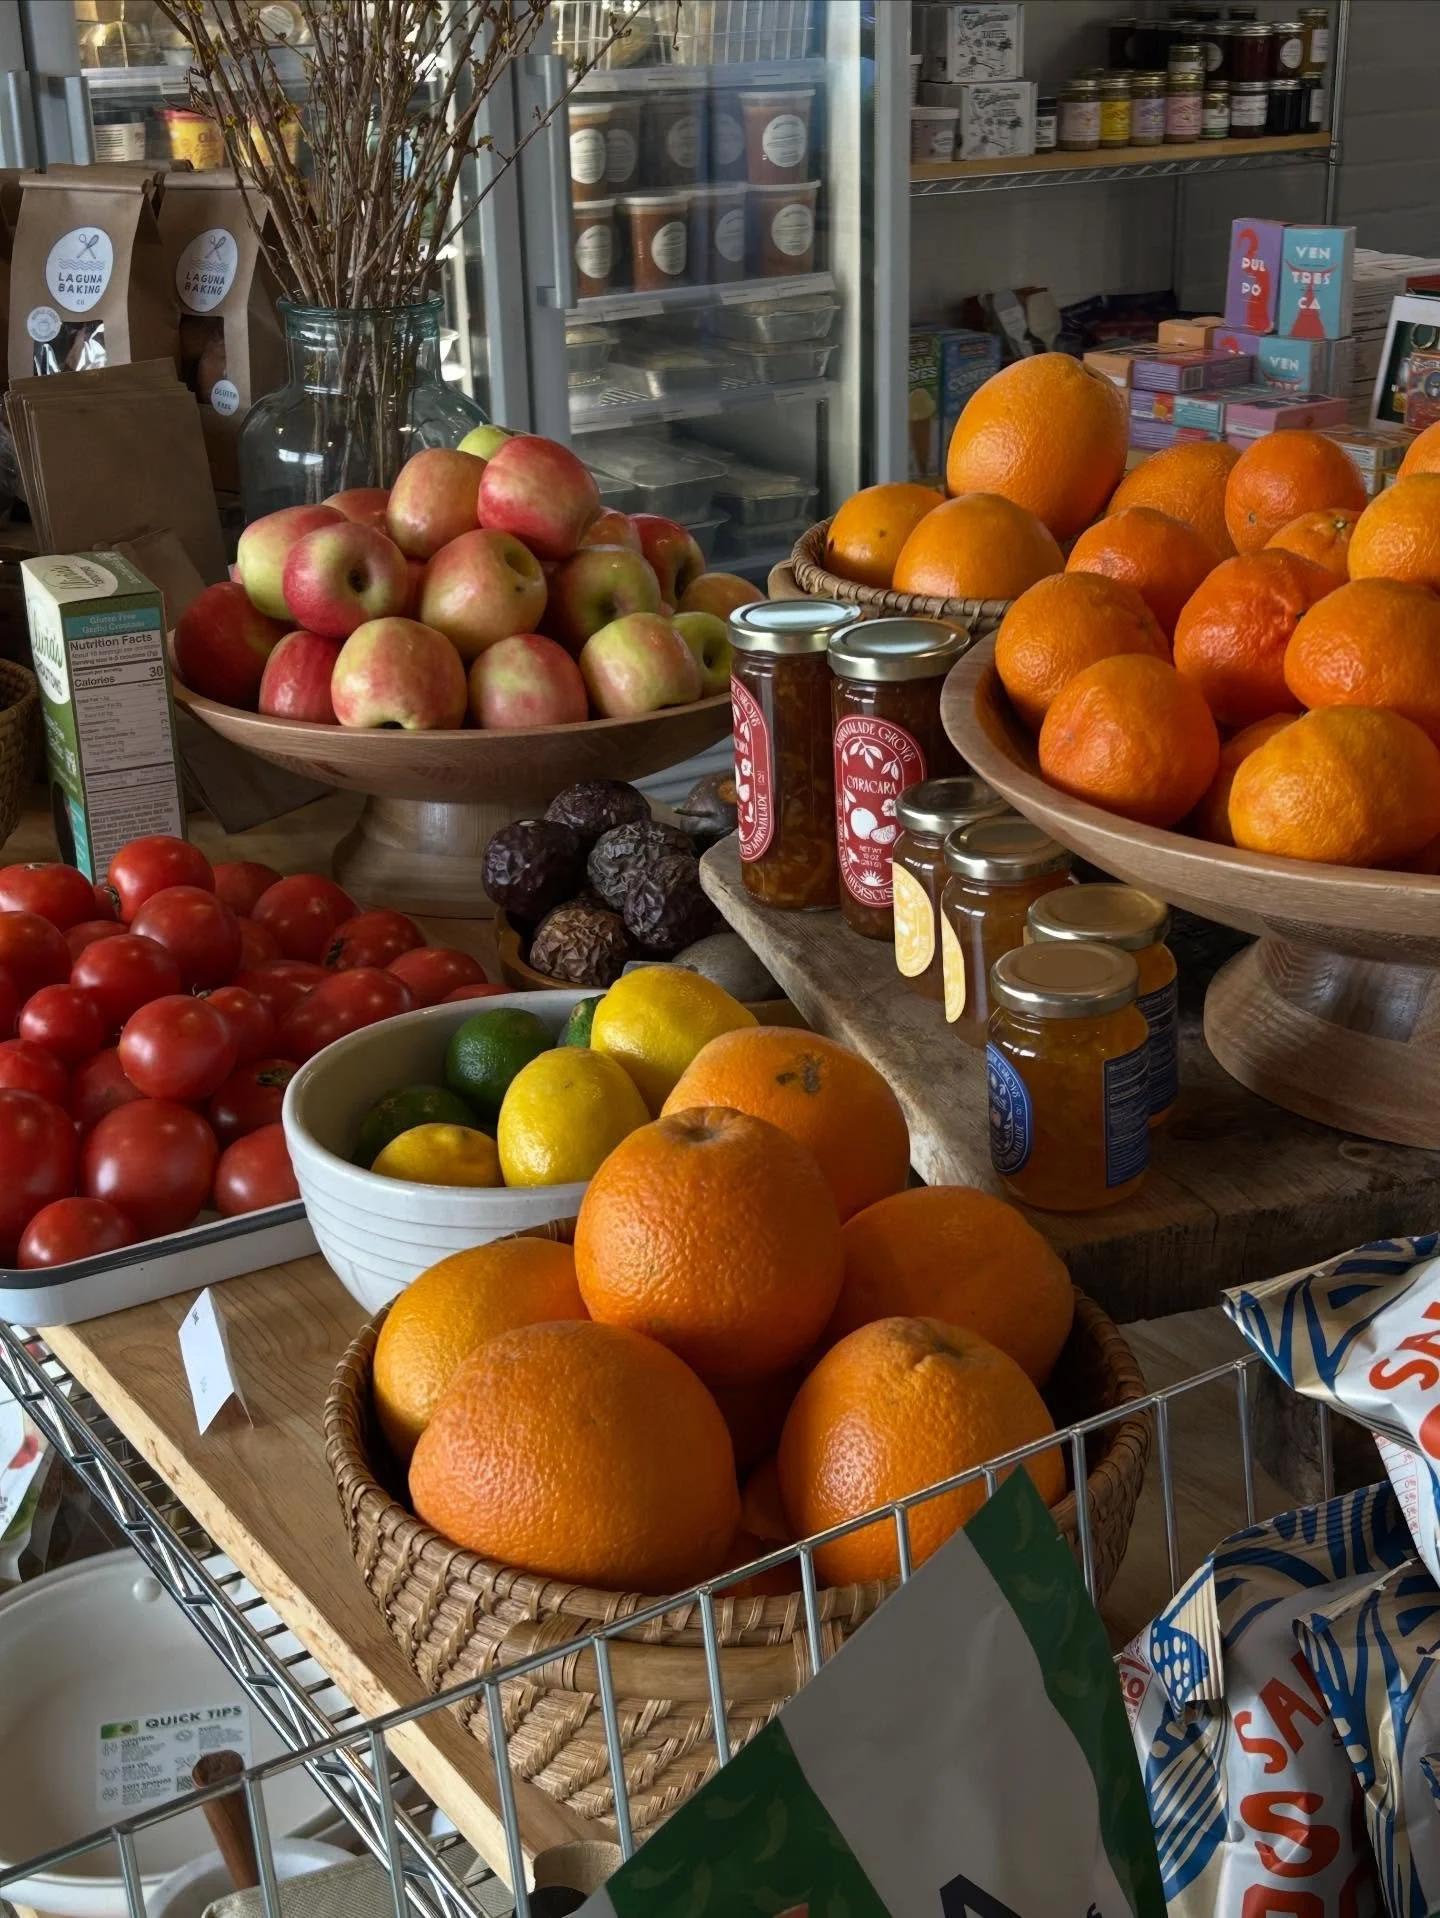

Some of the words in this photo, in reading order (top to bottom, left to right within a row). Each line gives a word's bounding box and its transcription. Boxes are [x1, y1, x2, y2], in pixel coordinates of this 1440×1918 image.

[1296, 246, 1331, 260] VEN
[1241, 257, 1267, 272] PUL
[58, 272, 103, 284] LAGUNA
[186, 272, 226, 285] LAGUNA
[1292, 271, 1331, 286] TRES
[58, 283, 101, 295] BAKING
[184, 282, 223, 295] BAKING
[1241, 282, 1262, 297] PO
[1297, 296, 1321, 310] CA
[1269, 356, 1300, 371] VEN
[70, 638, 119, 650] Nutrition
[122, 634, 152, 645] Facts
[149, 665, 164, 678] 30
[75, 675, 116, 688] Calories
[878, 727, 917, 763] GROVE
[145, 1711, 201, 1729] QUICK
[207, 1705, 243, 1720] TIPS
